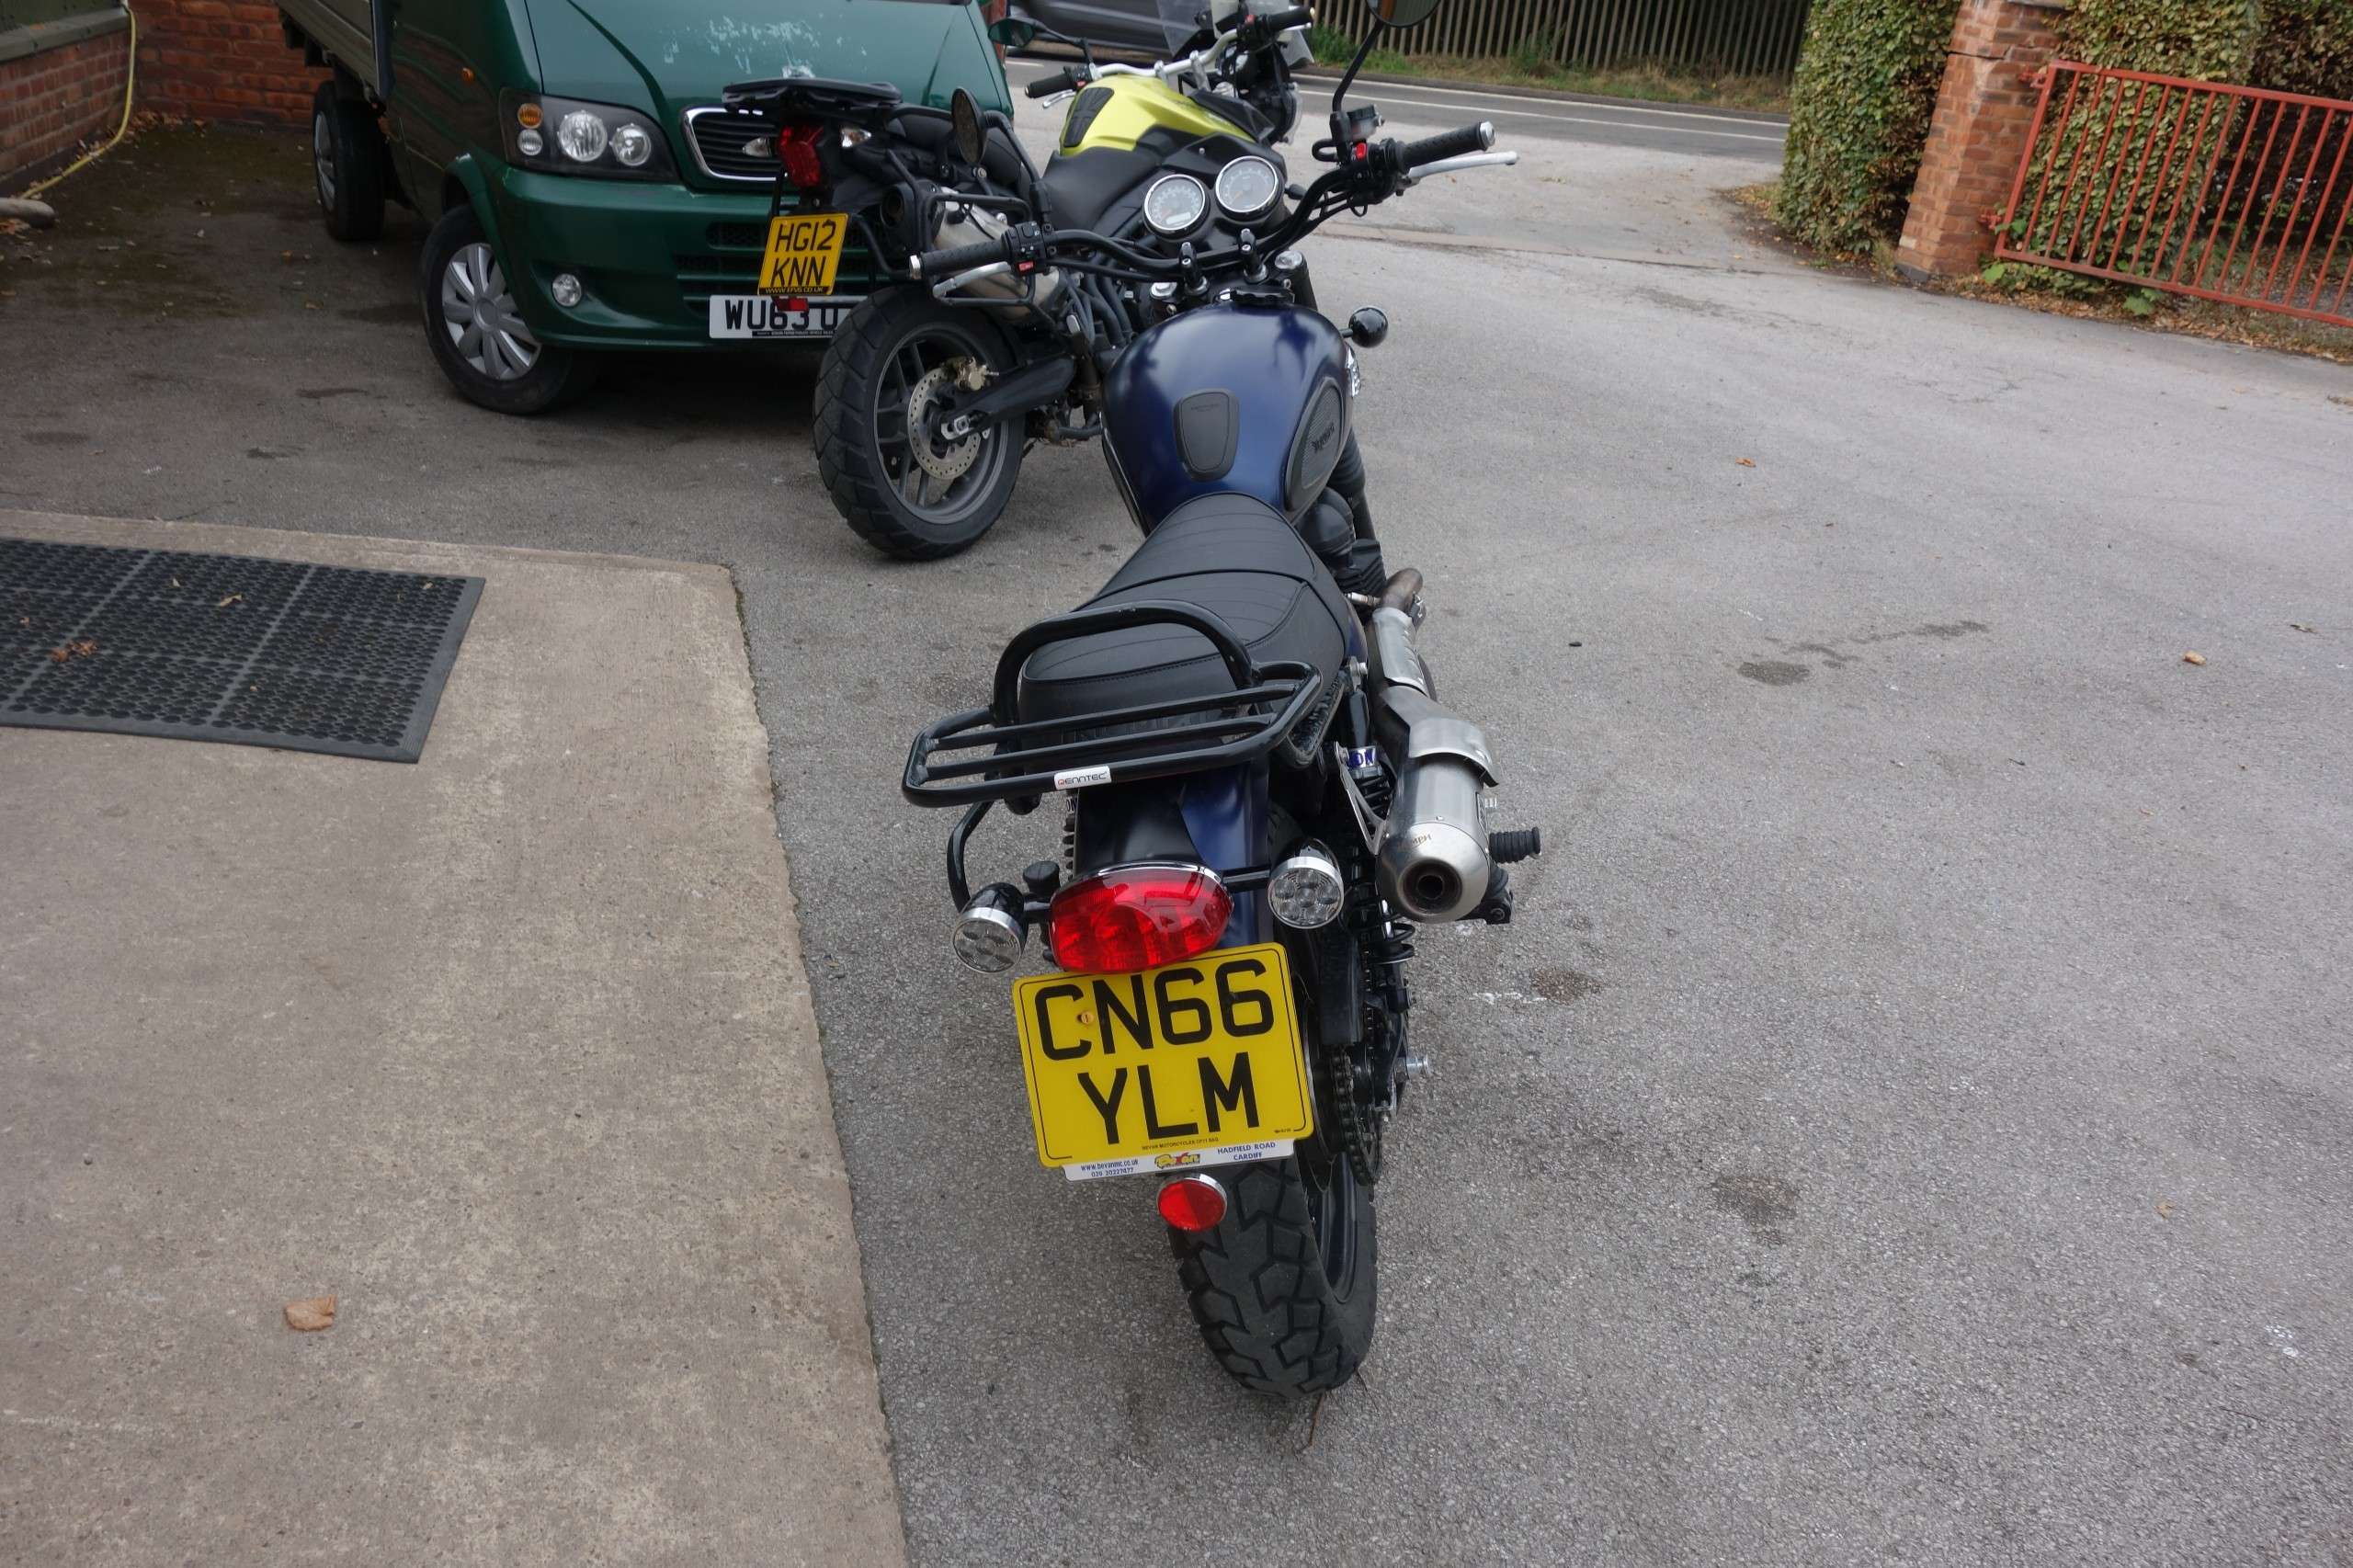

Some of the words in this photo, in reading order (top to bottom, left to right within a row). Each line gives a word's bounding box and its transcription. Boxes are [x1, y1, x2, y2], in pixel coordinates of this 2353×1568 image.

[774, 220, 836, 253] HG12
[770, 256, 826, 287] KNN
[725, 300, 810, 330] WU63
[1035, 959, 1275, 1061] CN66
[1077, 1051, 1259, 1145] YLM
[1217, 1144, 1251, 1154] HADFIELD
[1254, 1142, 1276, 1151] ROAD
[1233, 1152, 1263, 1162] CARDIFF
